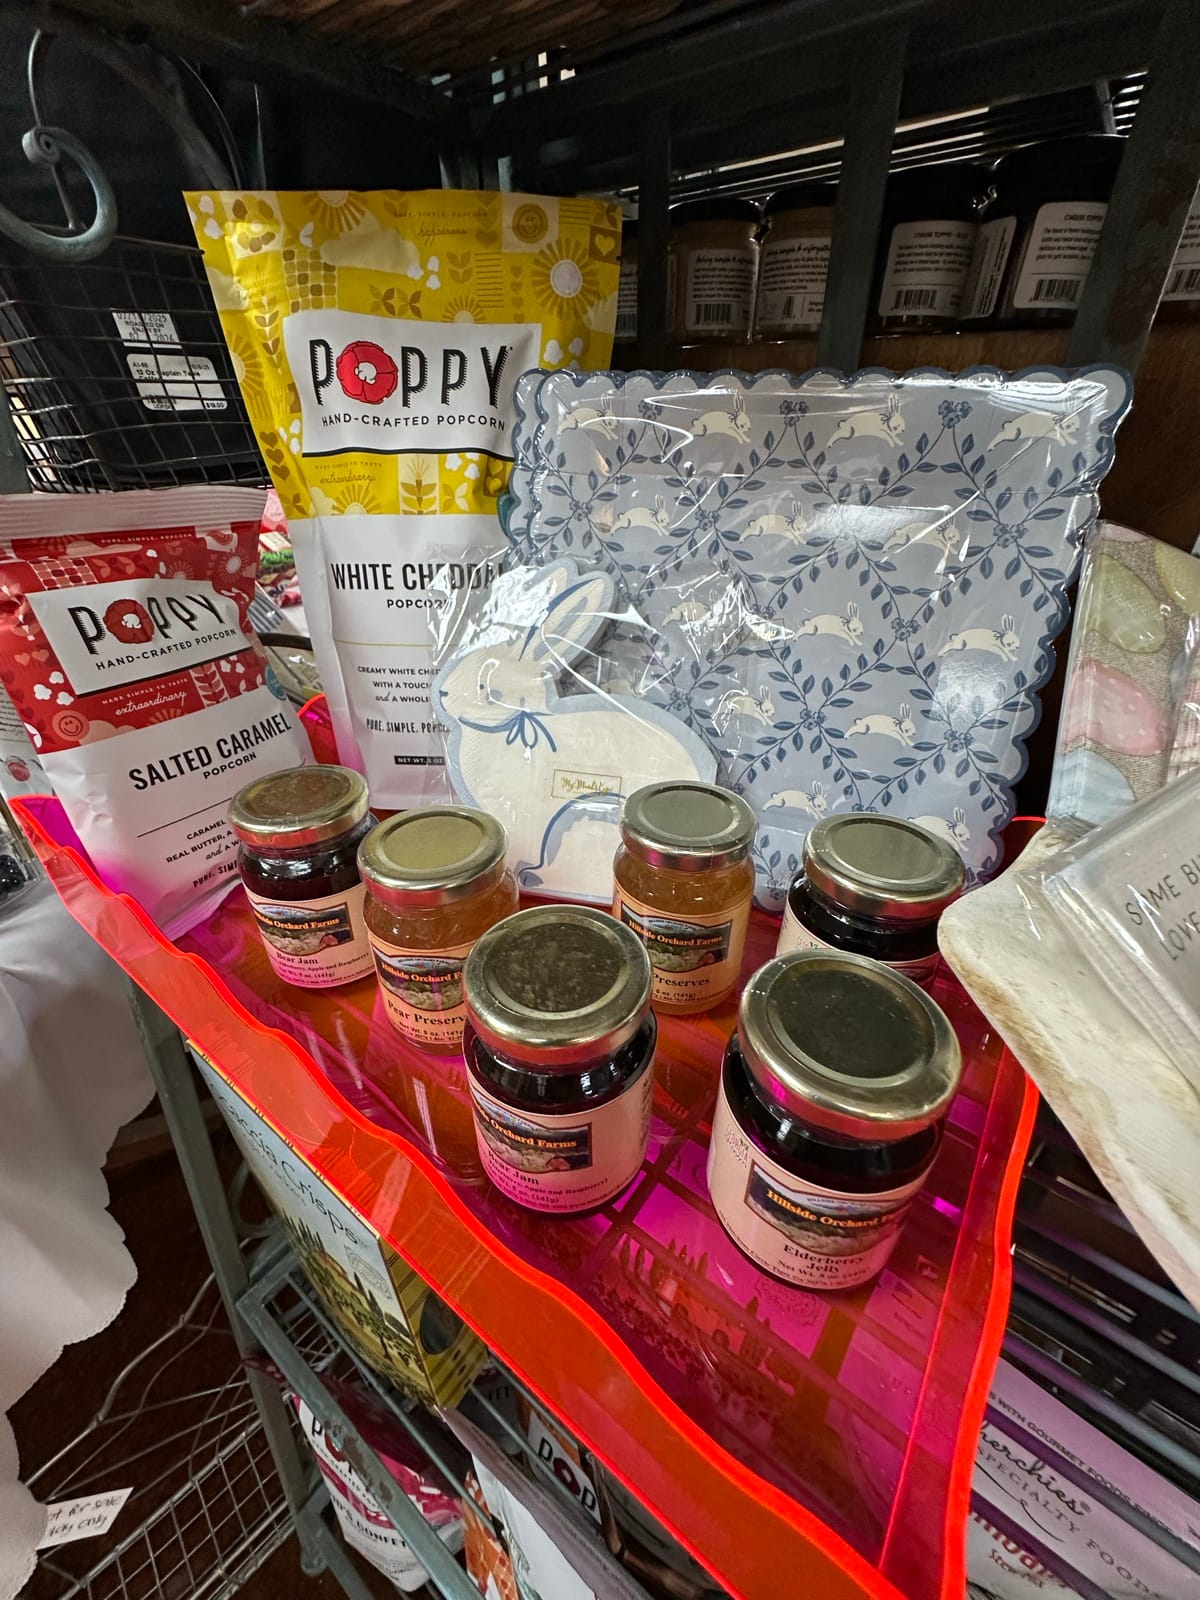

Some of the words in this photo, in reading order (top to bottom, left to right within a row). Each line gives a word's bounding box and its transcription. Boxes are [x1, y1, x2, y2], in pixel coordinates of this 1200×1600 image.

[309, 338, 509, 409] POPPY
[322, 413, 430, 428] HAND-CRAFTED
[437, 414, 506, 431] POPCORN
[331, 563, 395, 591] WHITE
[67, 593, 229, 656] POPPY
[96, 640, 193, 671] HAND-CRAFTED
[195, 628, 237, 646] POPCORN
[358, 666, 387, 674] CREAMY
[115, 691, 187, 716] extraordinary
[386, 721, 419, 733] SIMPLE.
[129, 745, 212, 790] SALTED
[216, 712, 292, 758] CARAMEL
[203, 751, 257, 779] POPCORN
[187, 819, 226, 840] CARAMEL
[166, 850, 190, 863] REAL
[191, 834, 225, 853] BUTTER,
[205, 843, 223, 860] and
[273, 920, 309, 930] Orchard
[310, 917, 340, 928] Farms
[657, 935, 694, 946] Orchard
[697, 935, 723, 946] Farms
[411, 972, 451, 982] Orchard
[387, 1000, 411, 1019] Pear
[414, 1013, 467, 1025] Preserv
[491, 1118, 534, 1147] Orchard
[537, 1138, 577, 1149] Farms
[513, 1171, 540, 1185] Jam
[281, 1160, 359, 1245] Crisps
[766, 1187, 818, 1221] Hillside
[820, 1216, 879, 1228] Orchard
[783, 1244, 864, 1265] Elderberry
[806, 1262, 839, 1274] Jelly
[999, 1397, 1026, 1424] WITH
[1027, 1421, 1087, 1467] GOURMET
[978, 1446, 1081, 1534] SPECIALTY
